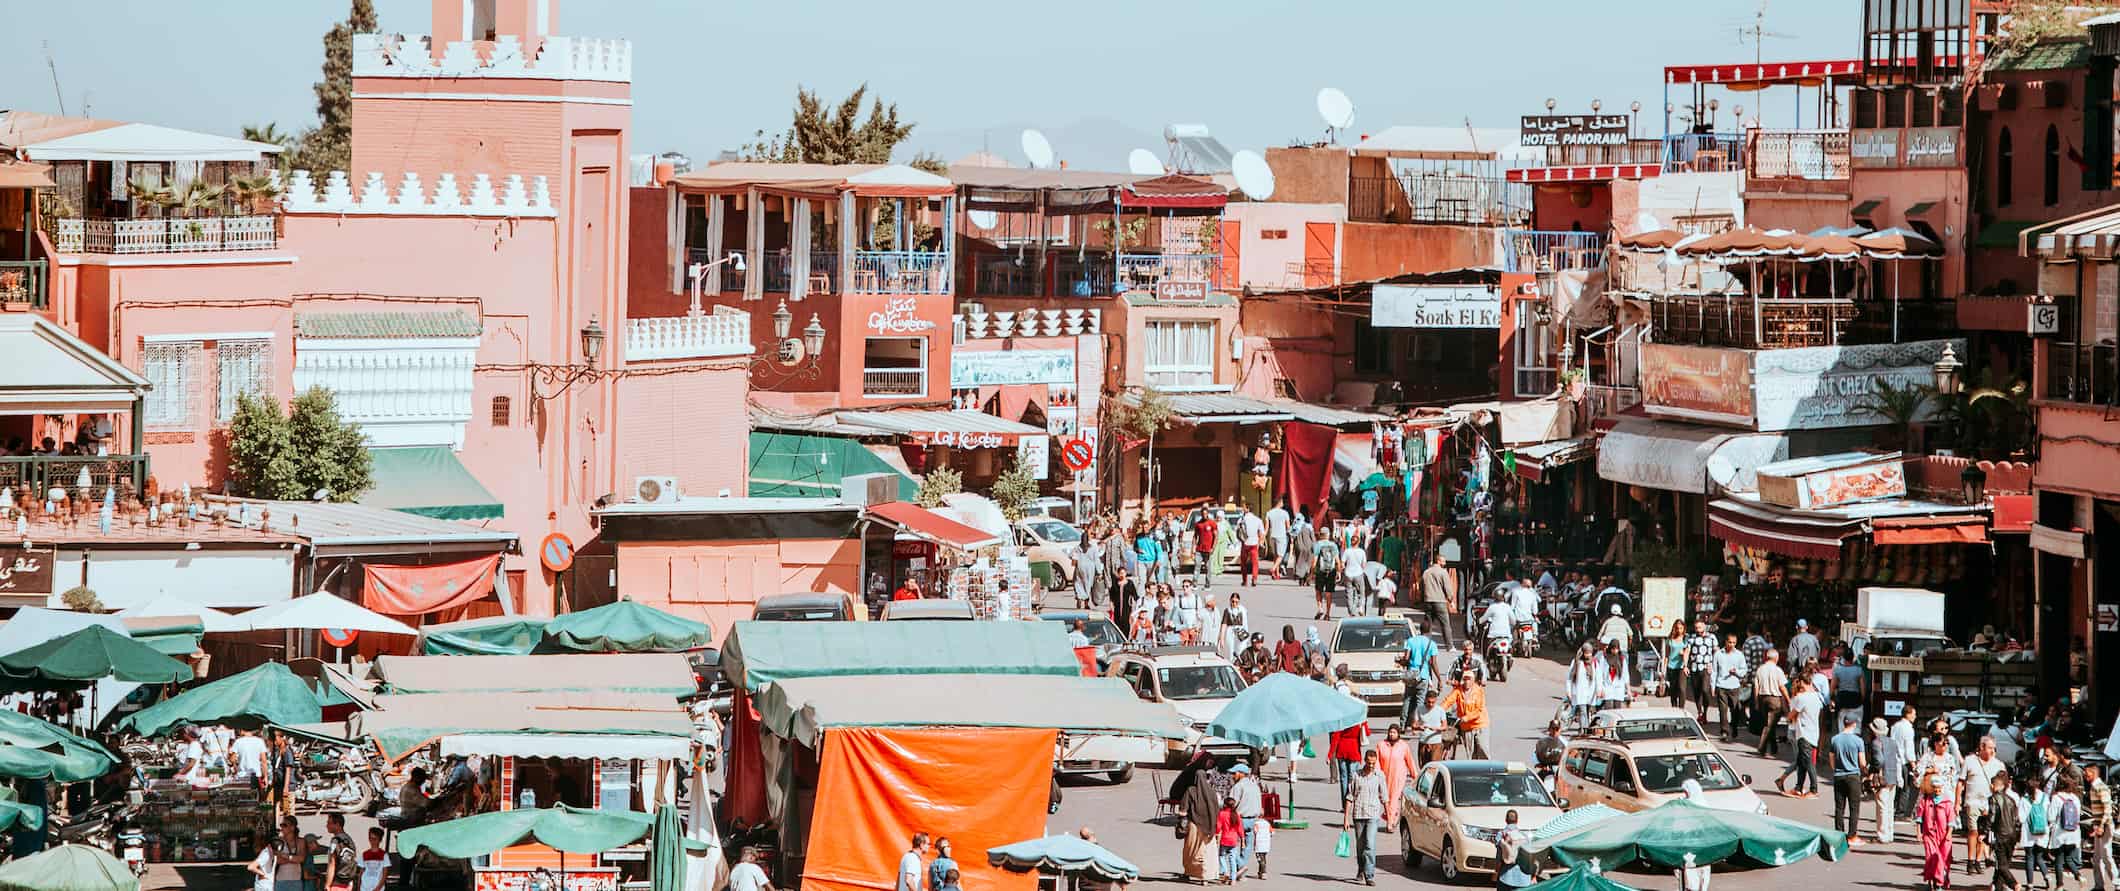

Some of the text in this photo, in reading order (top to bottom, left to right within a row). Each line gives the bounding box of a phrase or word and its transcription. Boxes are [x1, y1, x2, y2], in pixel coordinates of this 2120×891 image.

[1589, 116, 1626, 129] فندق
[1522, 132, 1627, 145] HOTEL PANORAMA
[1460, 309, 1475, 325] El
[1839, 375, 1869, 396] CHEZ
